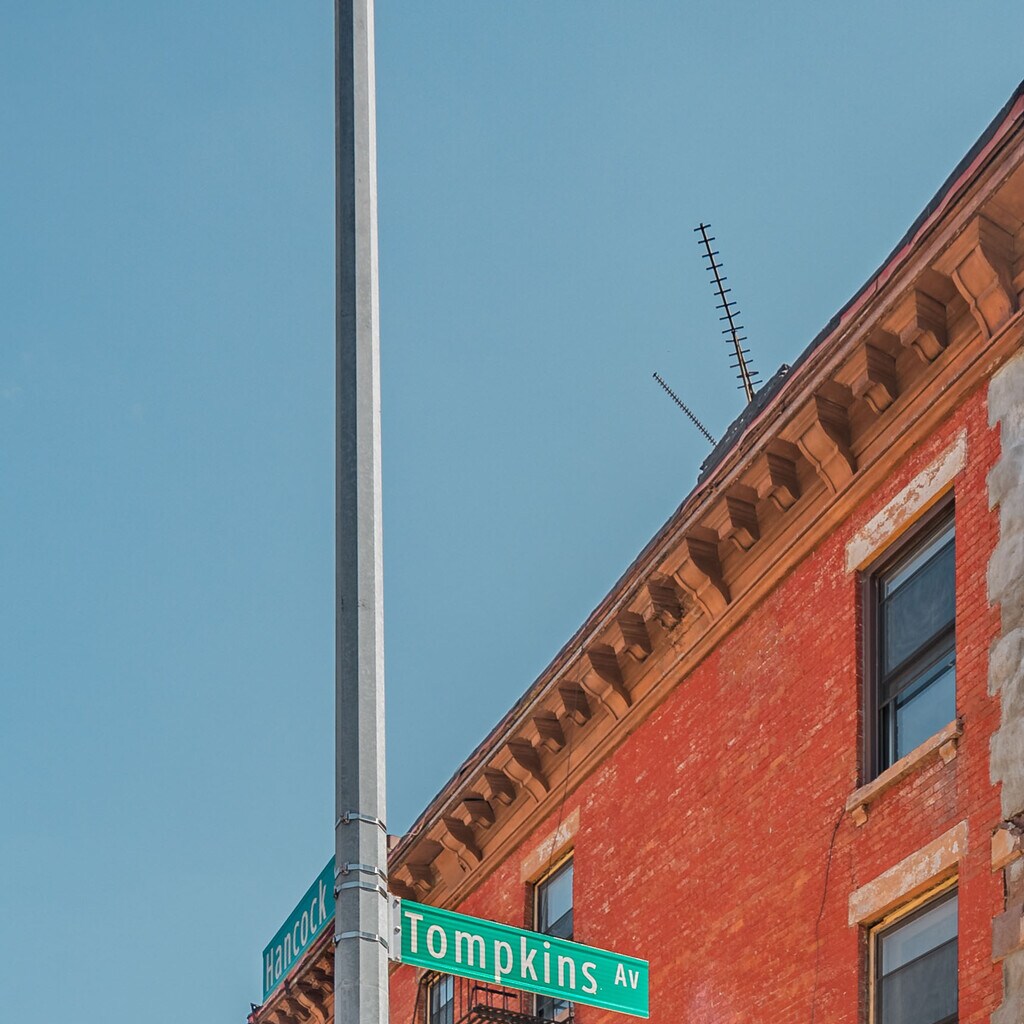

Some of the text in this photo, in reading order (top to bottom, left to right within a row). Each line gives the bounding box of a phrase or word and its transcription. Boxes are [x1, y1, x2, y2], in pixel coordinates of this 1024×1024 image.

[265, 880, 327, 992] Hancock
[404, 911, 640, 995] Tompkins Av
